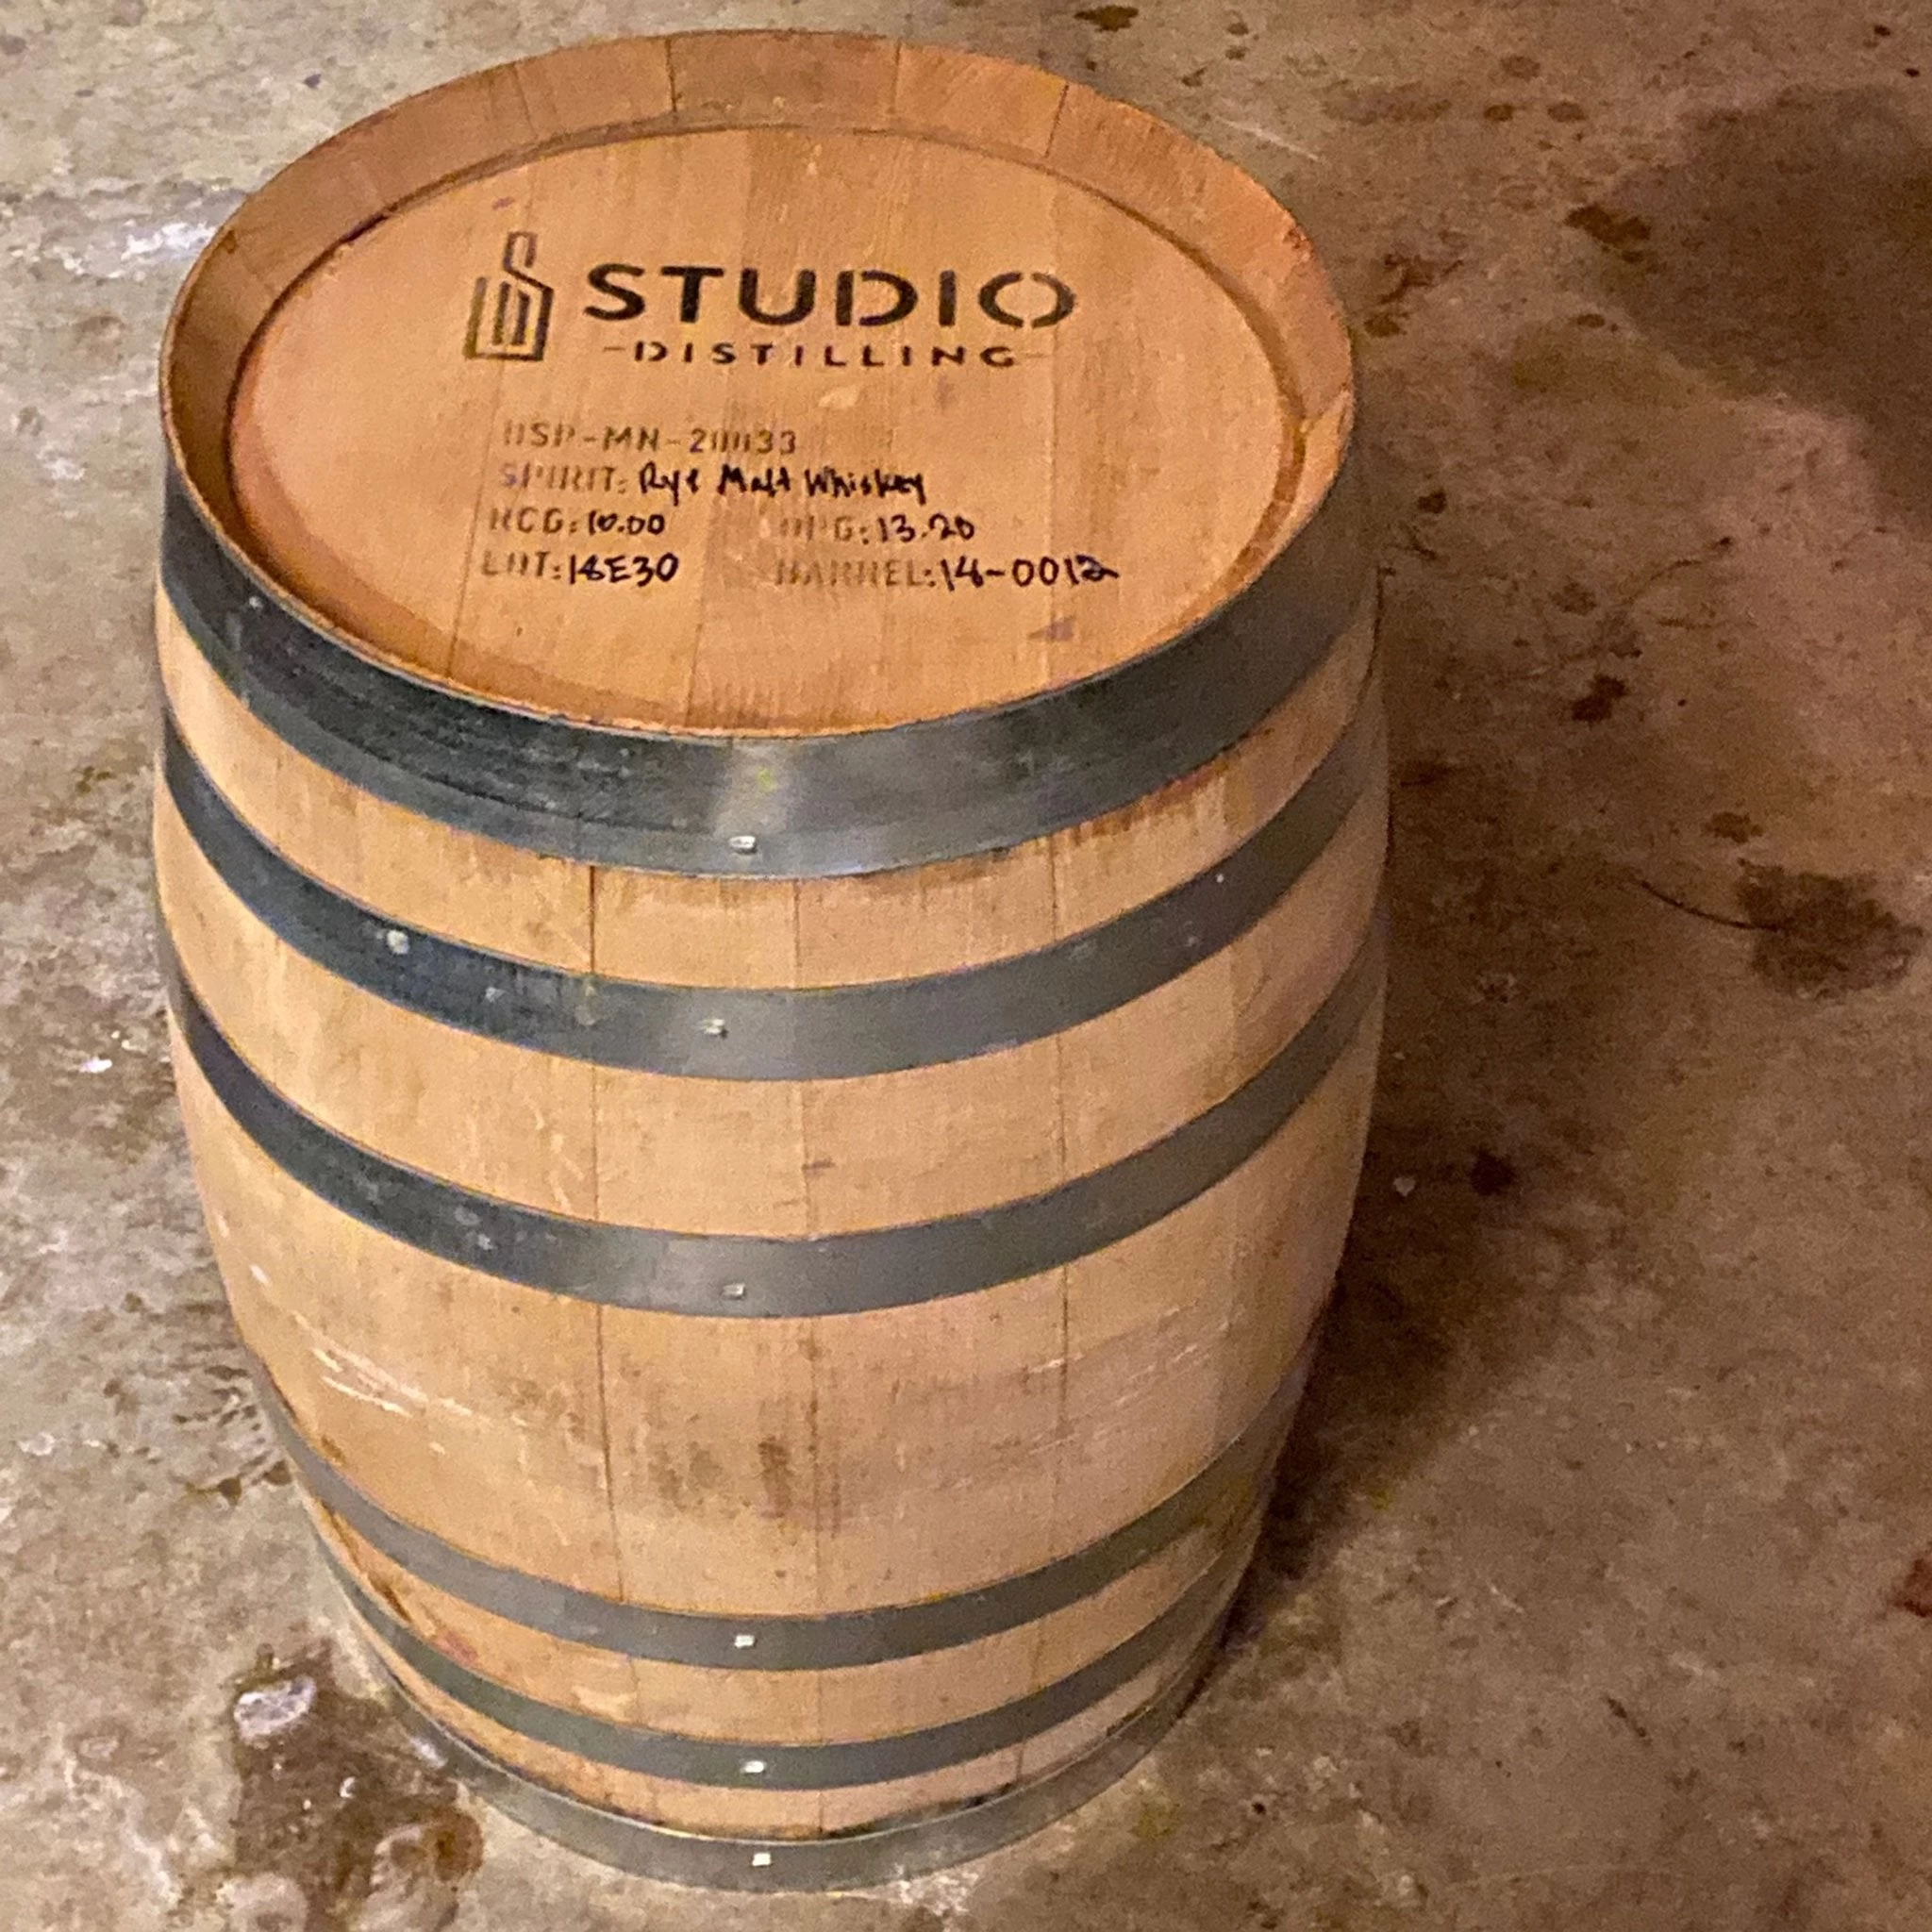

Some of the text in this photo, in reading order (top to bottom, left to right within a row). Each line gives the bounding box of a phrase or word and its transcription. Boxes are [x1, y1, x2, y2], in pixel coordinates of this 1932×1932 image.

[583, 262, 1077, 328] STUDIO
[634, 341, 1016, 367] DISTILLING
[639, 460, 699, 507] Rye
[804, 466, 926, 506] Whiskey
